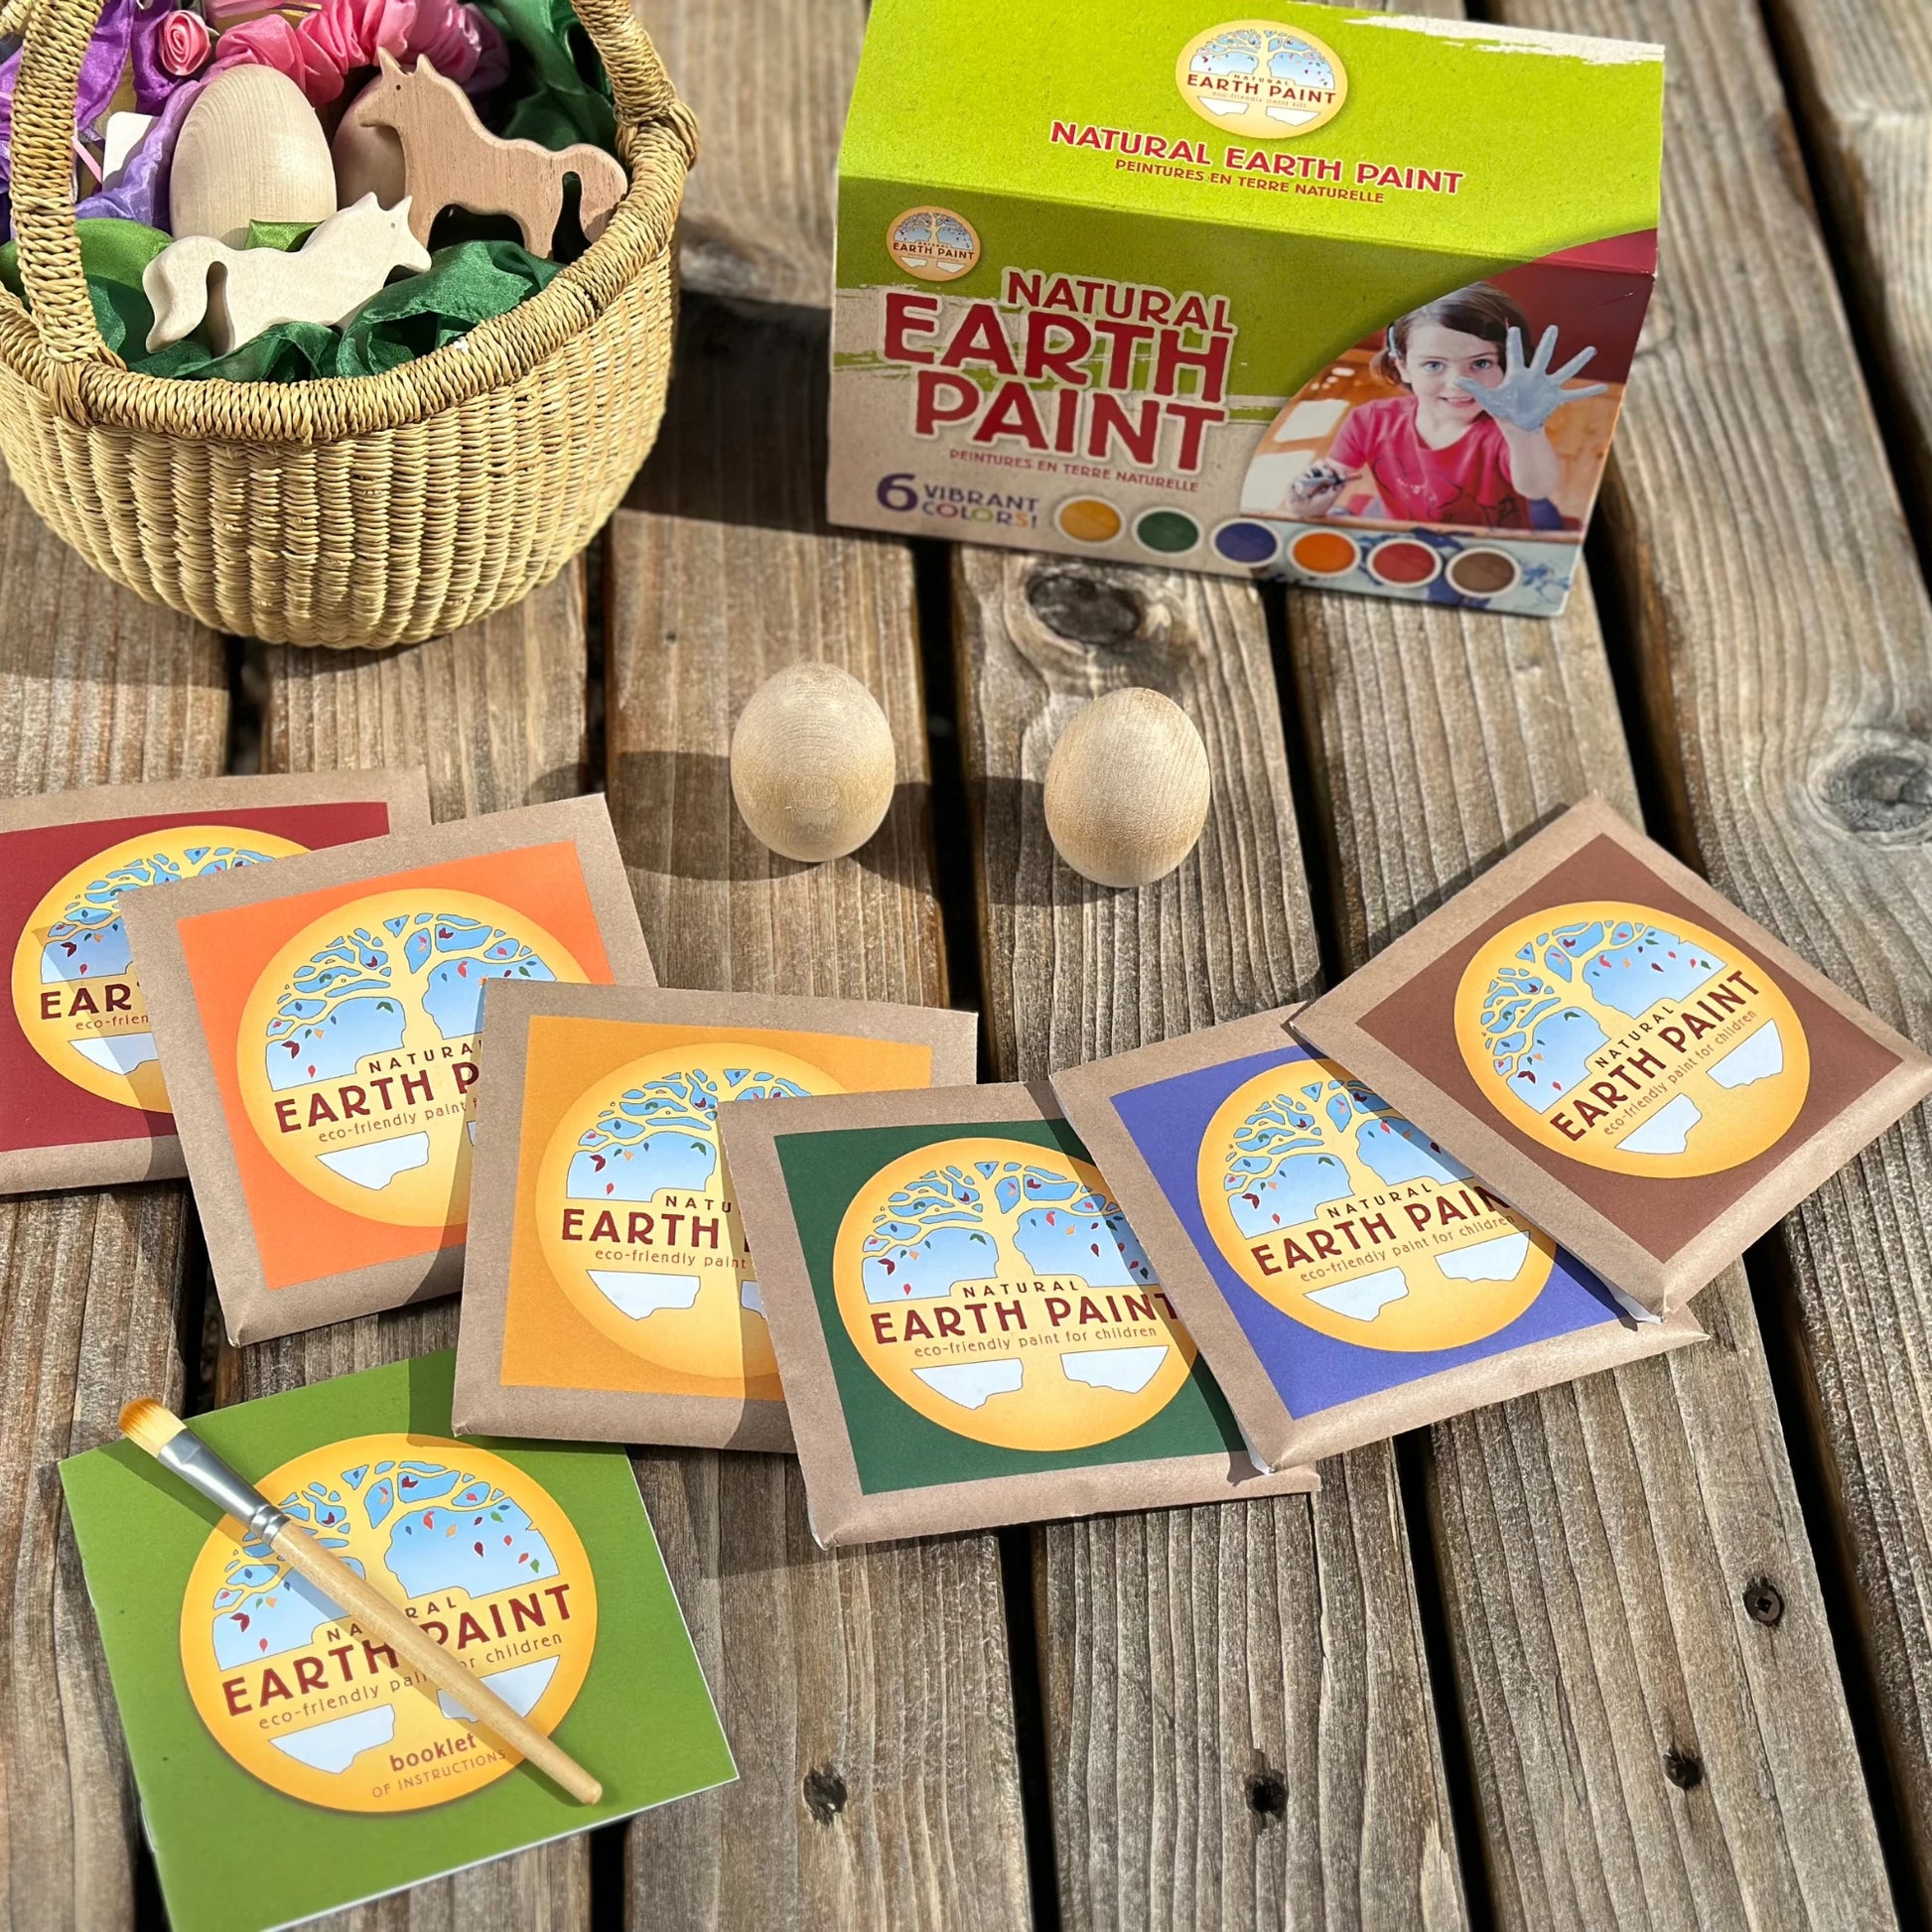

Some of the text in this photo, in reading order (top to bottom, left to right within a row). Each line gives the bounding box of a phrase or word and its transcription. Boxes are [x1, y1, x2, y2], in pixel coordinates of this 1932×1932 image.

[1187, 73, 1335, 104] EARTH PAINT
[1234, 74, 1289, 85] NATURAL
[1050, 121, 1463, 194] NATURAL EARTH PAINT
[1115, 159, 1384, 204] PEINTURES EN TERRE NATURELLE
[894, 242, 932, 254] EARTH
[937, 247, 974, 259] PAINT
[1008, 271, 1233, 334] NATURAL
[885, 293, 1229, 402] EARTH
[915, 370, 1225, 471] PAINT
[949, 450, 1198, 492] PEINTURES EN TERRE NATURELLE
[877, 473, 1039, 512] 6 VIBRANT
[922, 500, 1038, 529] COLORS!
[41, 981, 140, 1020] EAR
[75, 1014, 149, 1031] eco-frien
[1594, 1006, 1674, 1068] NATURAL
[368, 1040, 482, 1073] NATURA
[1550, 970, 1759, 1142] EARTH PAINT
[1603, 1010, 1757, 1136] eco-friendly paint for children
[274, 1069, 434, 1133] EARTH
[319, 1111, 416, 1142] eco-friendly
[425, 1101, 467, 1121] paint
[666, 1195, 736, 1213] NATU
[1326, 1183, 1432, 1218] NATURAL
[562, 1208, 720, 1249] EARTH
[1251, 1185, 1510, 1277] EARTH PAIN
[1300, 1215, 1515, 1283] eco-friendly paint for children
[595, 1249, 747, 1270] eco-friendly paint
[962, 1280, 1079, 1298] NATURAL
[871, 1293, 1178, 1344] EARTH PAINT
[913, 1325, 1158, 1357] eco-friendly paint for children
[327, 1596, 457, 1642] NARAL
[222, 1639, 399, 1716] EARTH
[259, 1685, 379, 1729] eco-friendly
[485, 1633, 563, 1664] children
[372, 1748, 506, 1798] OF INSTRUCTIONS
[389, 1732, 477, 1772] booklet
